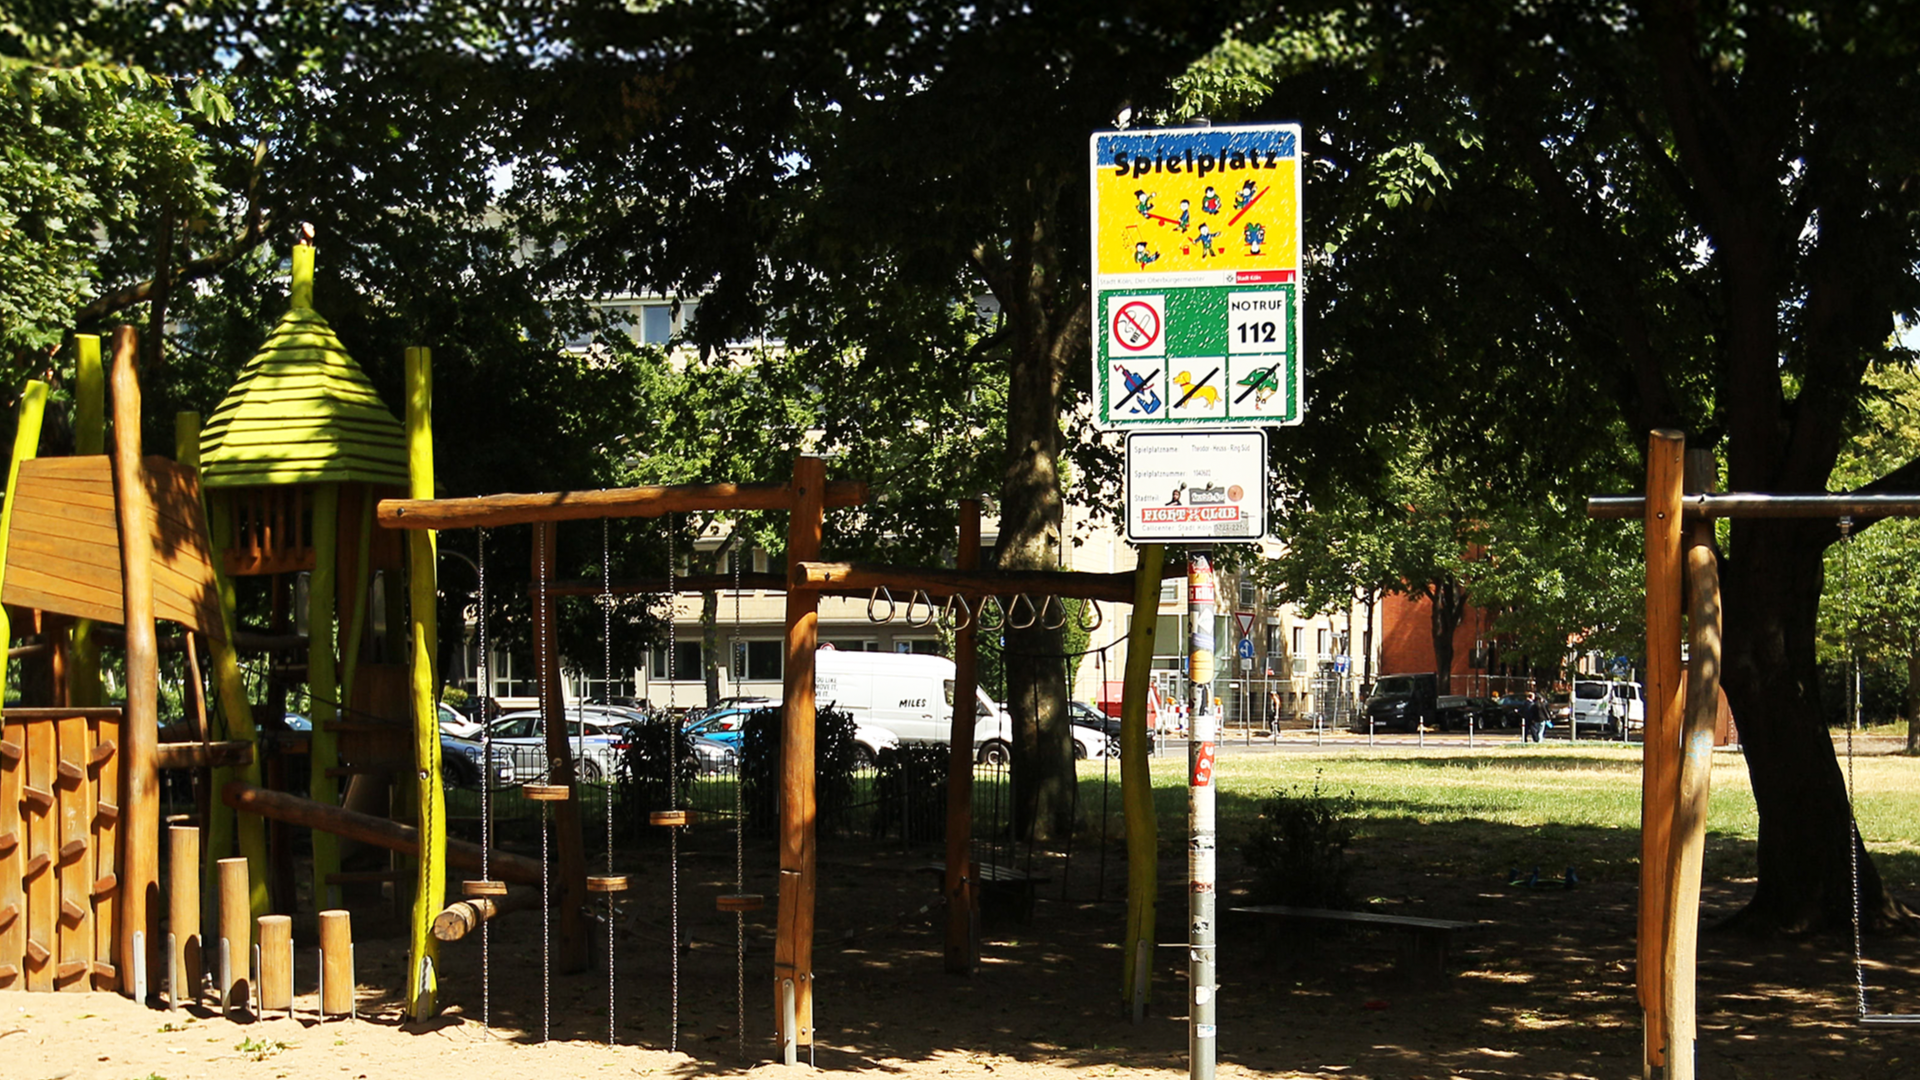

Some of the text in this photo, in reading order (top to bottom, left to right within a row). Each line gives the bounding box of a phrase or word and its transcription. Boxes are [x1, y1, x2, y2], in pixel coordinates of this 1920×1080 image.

[1114, 148, 1278, 178] Spielplatz
[1231, 300, 1282, 311] NOTRUF
[1237, 321, 1276, 343] 112
[1143, 507, 1237, 522] FIGHT CLUB
[899, 699, 927, 708] MILES
